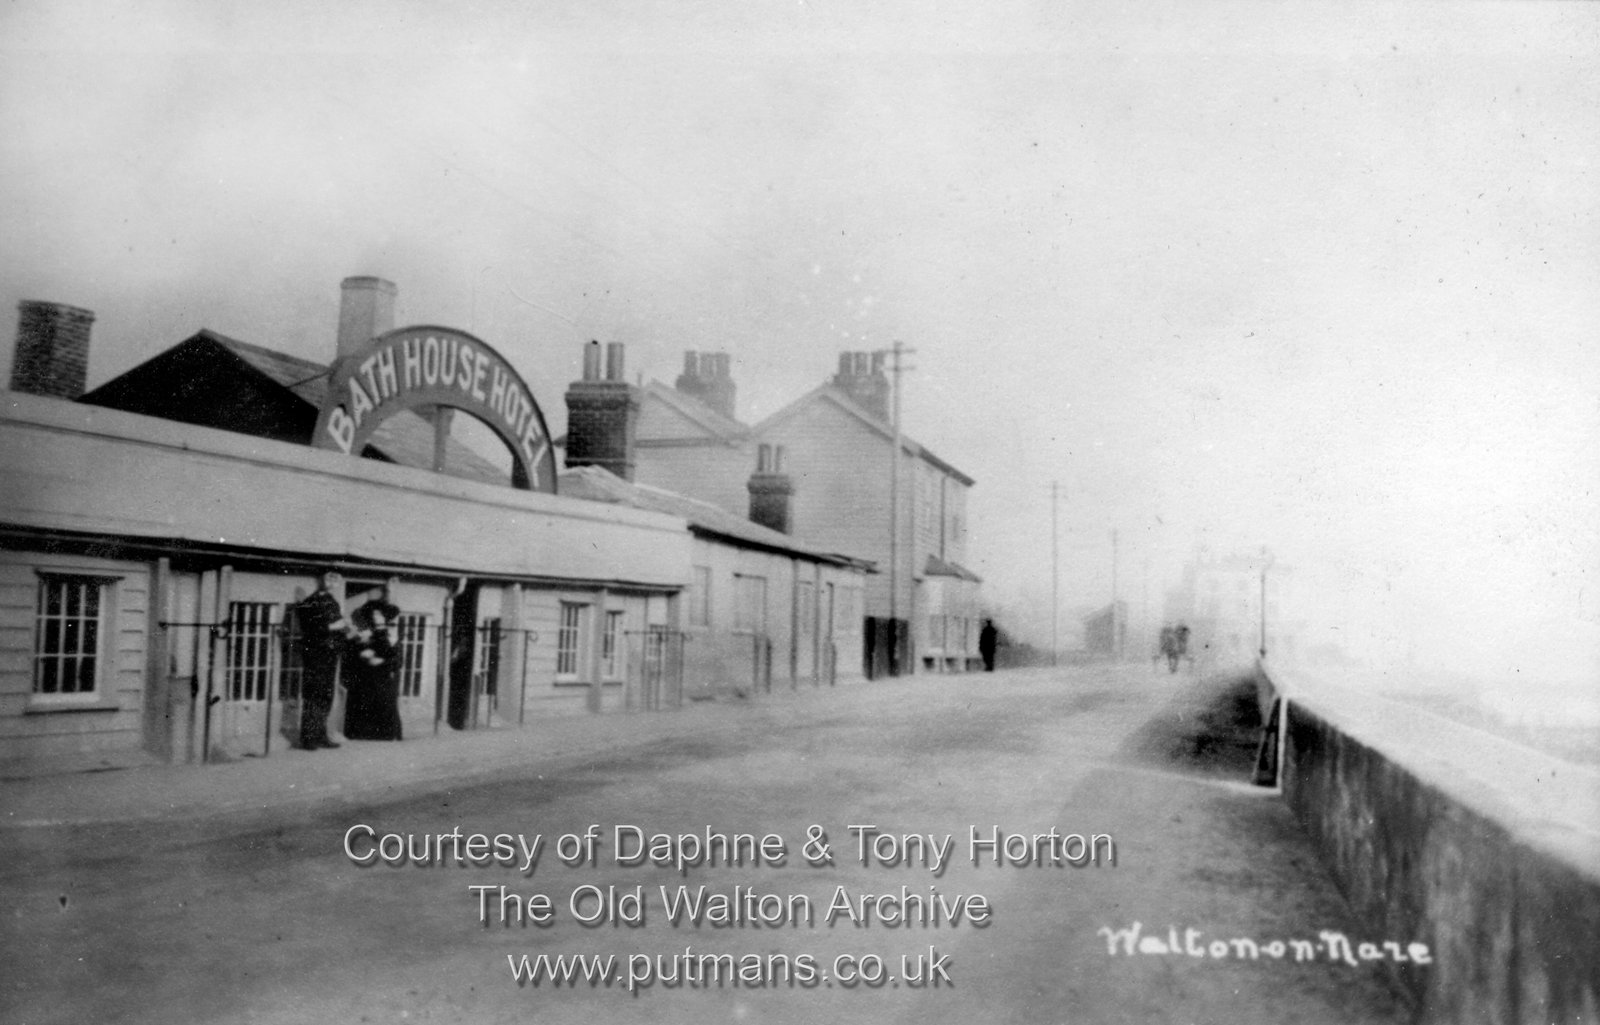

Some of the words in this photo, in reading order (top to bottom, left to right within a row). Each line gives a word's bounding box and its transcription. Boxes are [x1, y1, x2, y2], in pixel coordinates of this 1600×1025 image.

[327, 346, 398, 455] BATH
[403, 336, 489, 401] HOUSE
[490, 365, 548, 487] HOTEL
